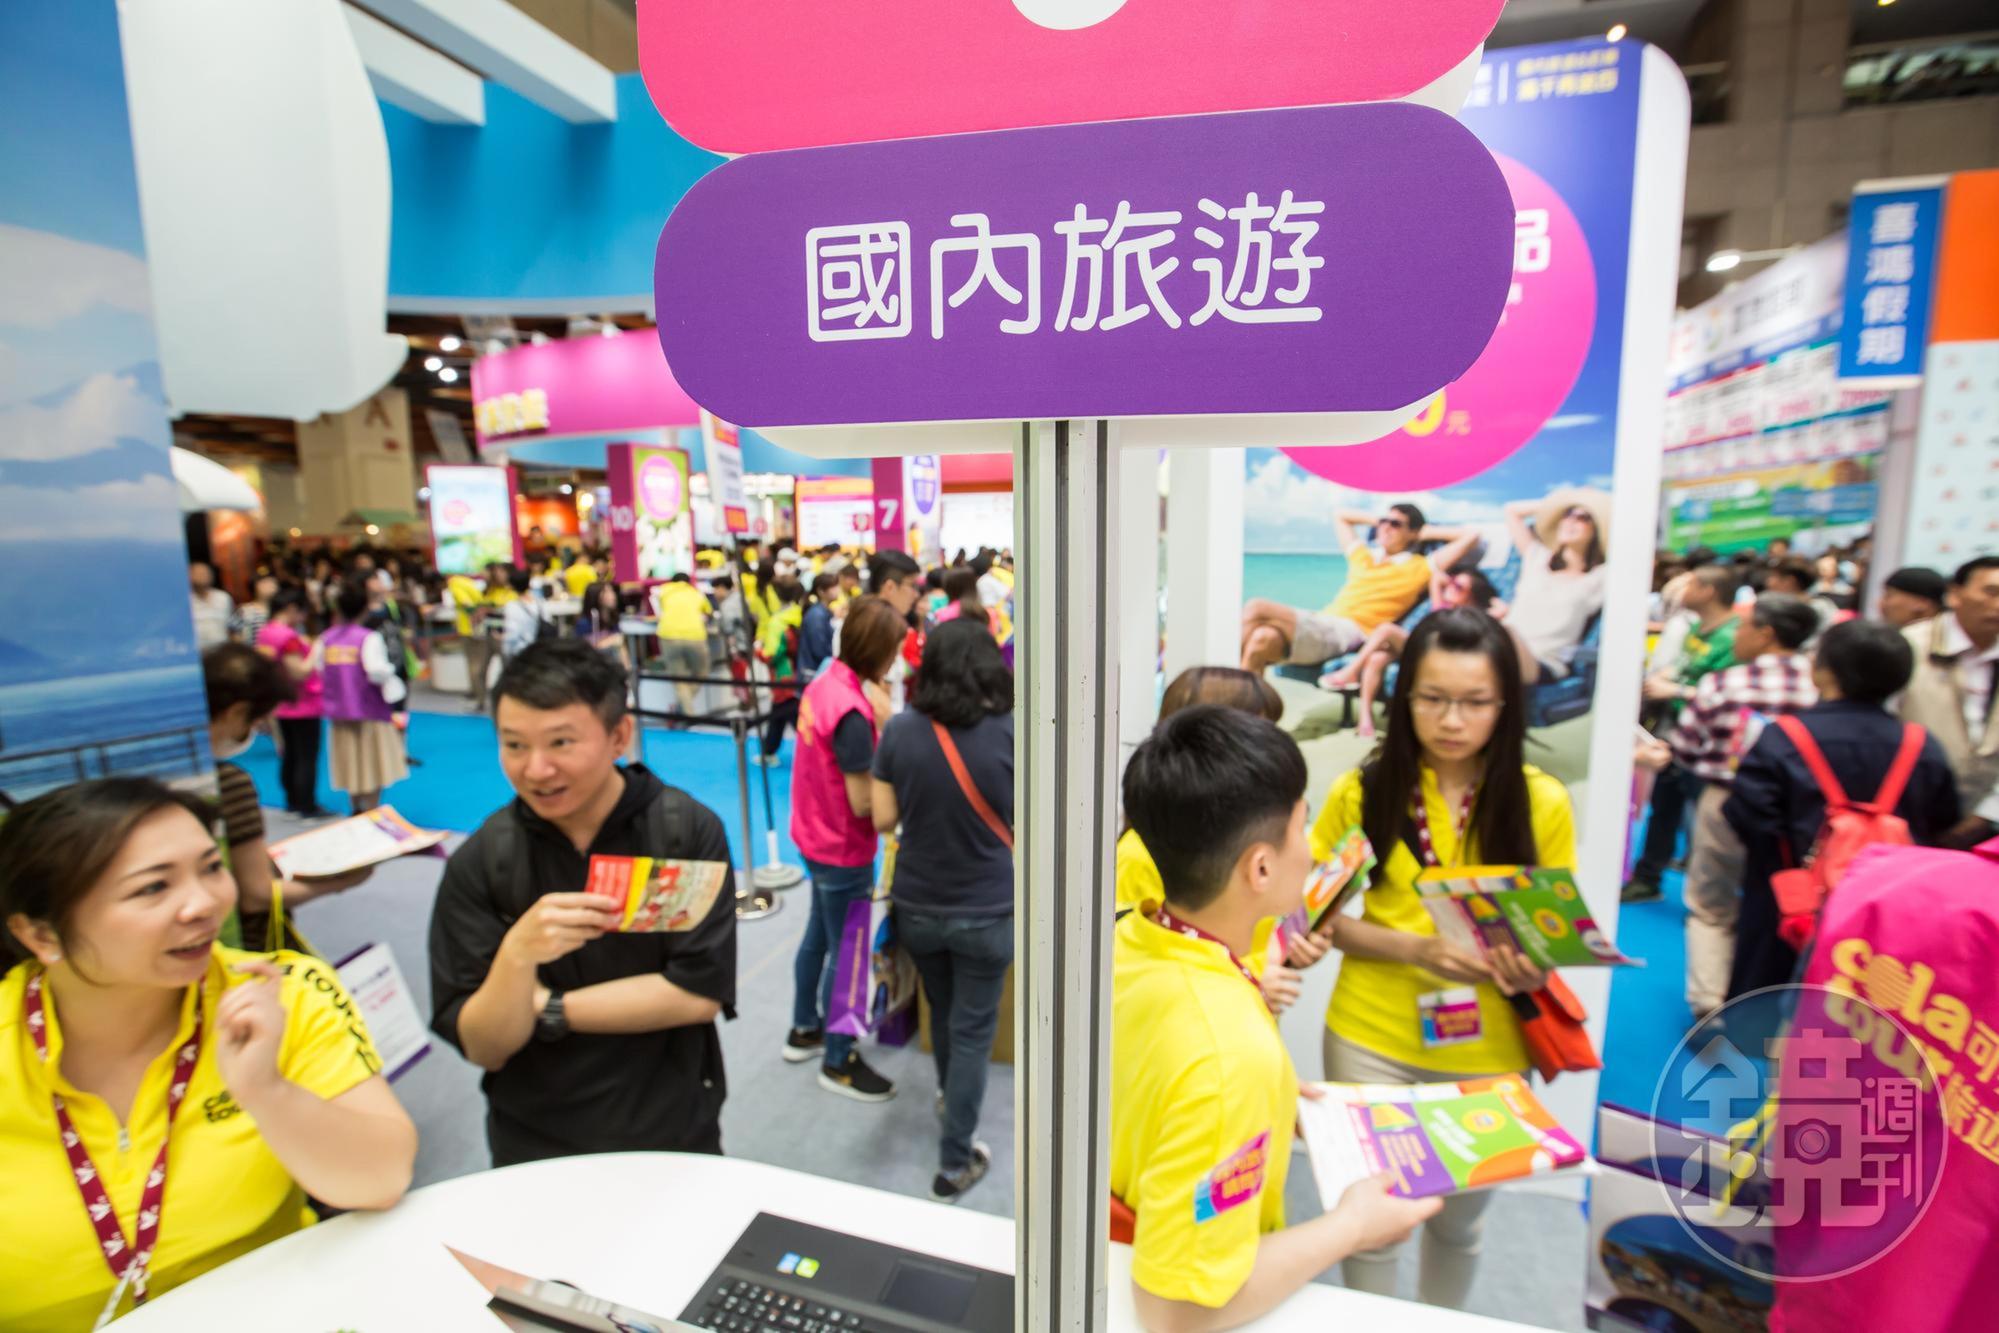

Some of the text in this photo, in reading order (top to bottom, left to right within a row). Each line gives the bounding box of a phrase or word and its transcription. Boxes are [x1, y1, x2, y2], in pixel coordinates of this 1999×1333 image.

[806, 190, 1326, 344] 國內旅遊
[1856, 202, 1919, 365] 喜鴻假期
[610, 505, 634, 531] 10
[878, 499, 900, 530] 7
